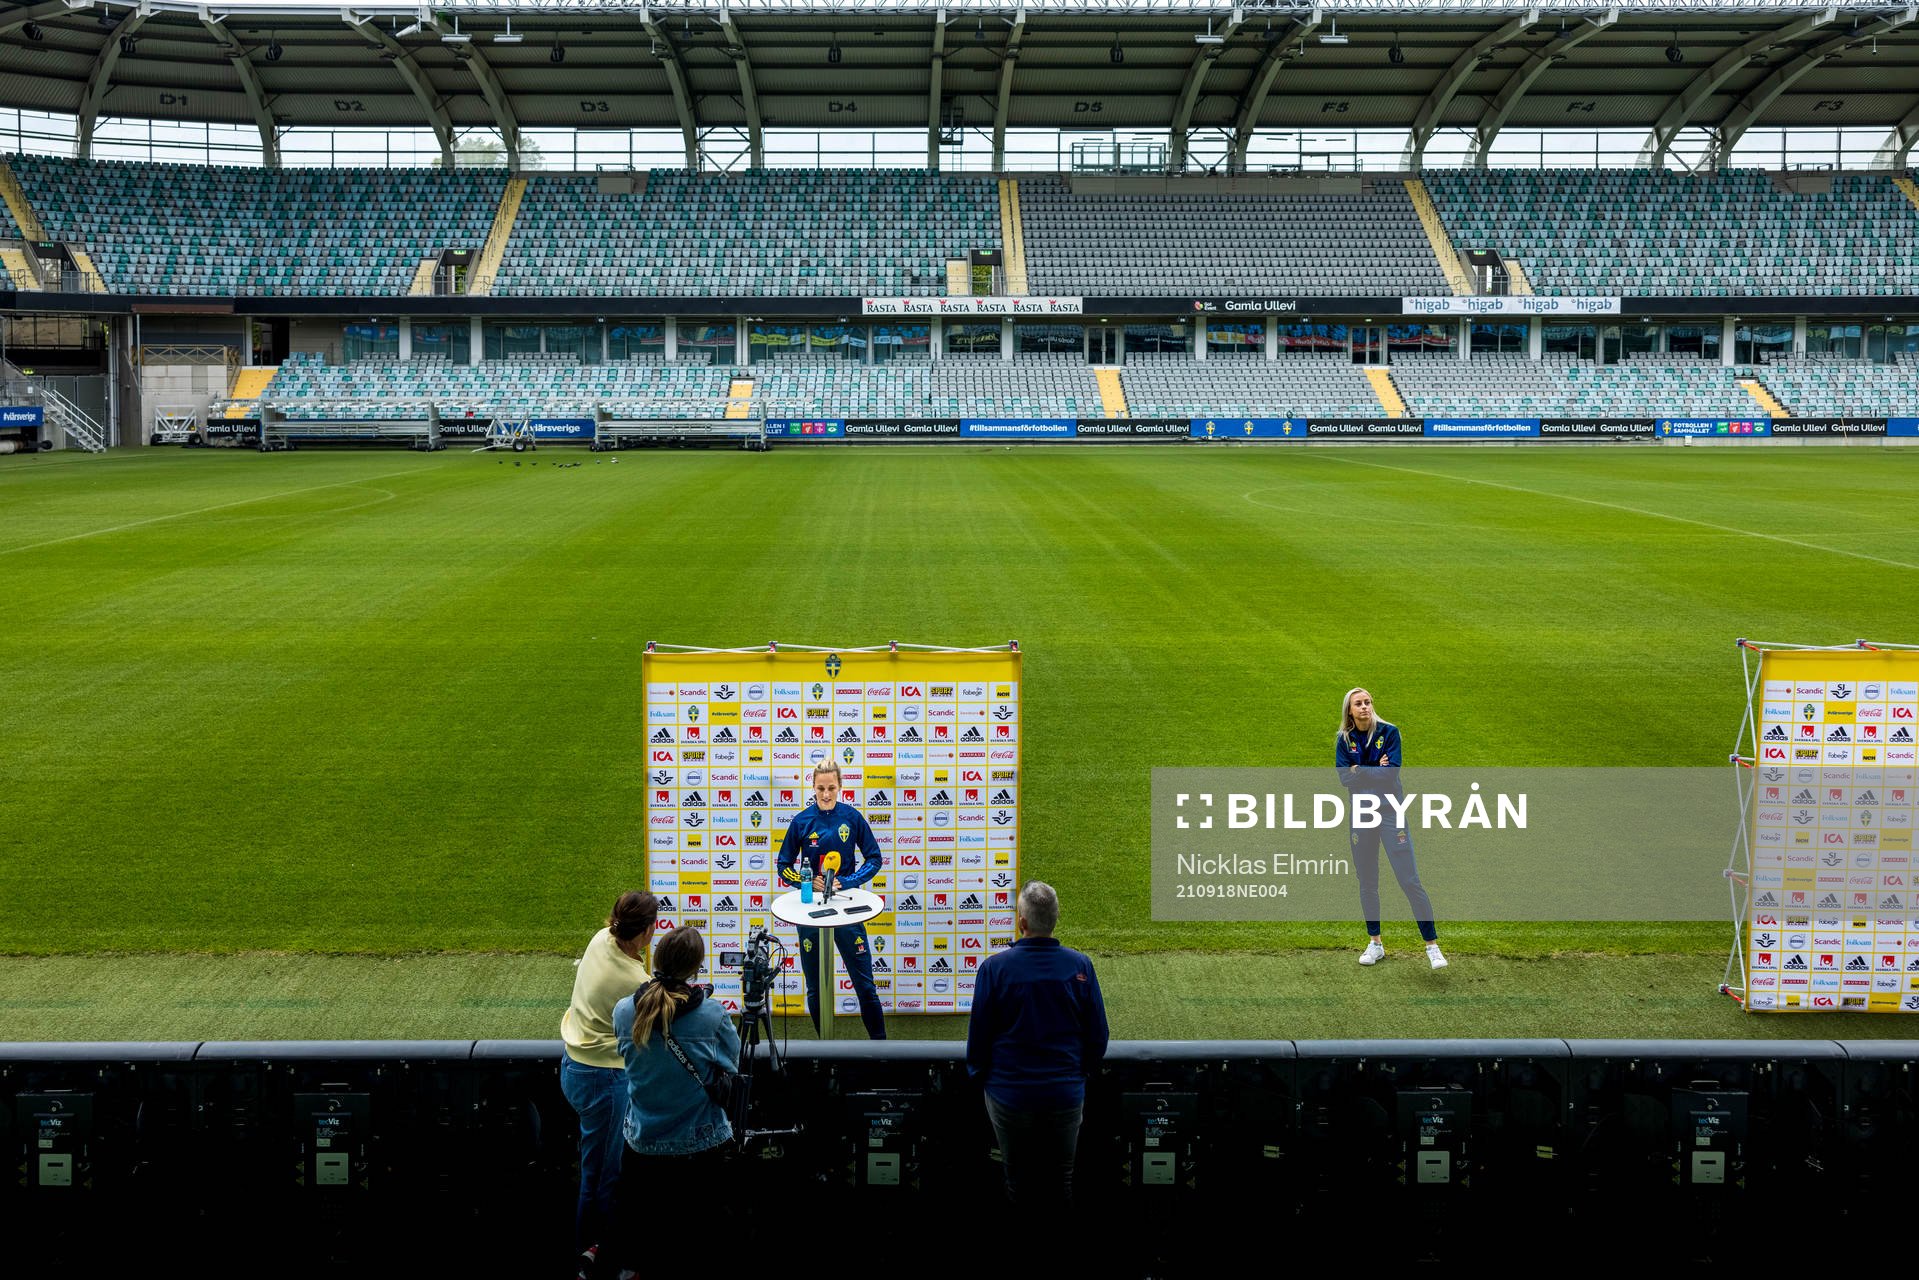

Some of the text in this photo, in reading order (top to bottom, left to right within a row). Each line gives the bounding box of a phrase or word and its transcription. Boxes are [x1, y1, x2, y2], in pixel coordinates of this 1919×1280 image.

[160, 94, 188, 106] D1
[335, 99, 366, 111] D2
[580, 101, 610, 112] D3
[829, 101, 857, 112] D4
[1074, 101, 1103, 112] D5
[1321, 101, 1350, 112] F5
[1566, 101, 1596, 112] F4
[1812, 100, 1844, 111] F3
[867, 303, 897, 312] RASTA
[903, 303, 933, 312] RASTA
[940, 303, 970, 312] RASTA
[976, 303, 1006, 312] RASTA
[1013, 303, 1043, 312] RASTA
[1050, 303, 1080, 312] RASTA
[1225, 301, 1296, 311] Gamla Ullevi
[1414, 298, 1450, 312] higab
[1467, 298, 1503, 312] higab
[1523, 298, 1559, 312] higab
[1576, 298, 1612, 312] higab
[232, 424, 257, 433] Ullevi
[529, 425, 581, 434] viärsverige
[846, 424, 874, 433] Gamla
[875, 424, 900, 433] Ullevi
[904, 424, 958, 433] Gamla Ullevi
[969, 424, 1068, 433] #tillsammansförfotbollen
[1077, 424, 1131, 433] Gamla Ullevi
[1136, 424, 1190, 433] Gamla Ullevi
[1310, 424, 1364, 433] Gamla Ullevi
[1368, 424, 1422, 433] Gamla Ullevi
[1433, 424, 1531, 432] #tillsammansförfotbollen
[1542, 424, 1596, 433] Gamla Ullevi
[1600, 424, 1654, 433] Gamla Ullevi
[1773, 424, 1801, 433] Gamla
[1802, 424, 1827, 433] Ullevi
[1831, 424, 1885, 433] Gamla Ullevi
[902, 687, 921, 696] ICA
[778, 708, 797, 718] ICA
[1893, 708, 1912, 718] ICA
[653, 752, 673, 761] ICA
[1766, 749, 1785, 758] ICA
[963, 771, 982, 781] ICA
[716, 836, 736, 845] ICA
[1824, 834, 1844, 843] ICA
[901, 856, 920, 865] ICA
[1884, 876, 1903, 885] ICA
[656, 920, 675, 929] ICA
[1757, 915, 1776, 925] ICA
[962, 938, 981, 948] ICA
[1814, 998, 1833, 1006] ICA
[667, 1039, 688, 1064] adidas
[318, 1118, 340, 1126] tecViz
[871, 1118, 893, 1126] tecViz
[1422, 1116, 1444, 1124] tecViz
[1698, 1116, 1720, 1124] tecViz
